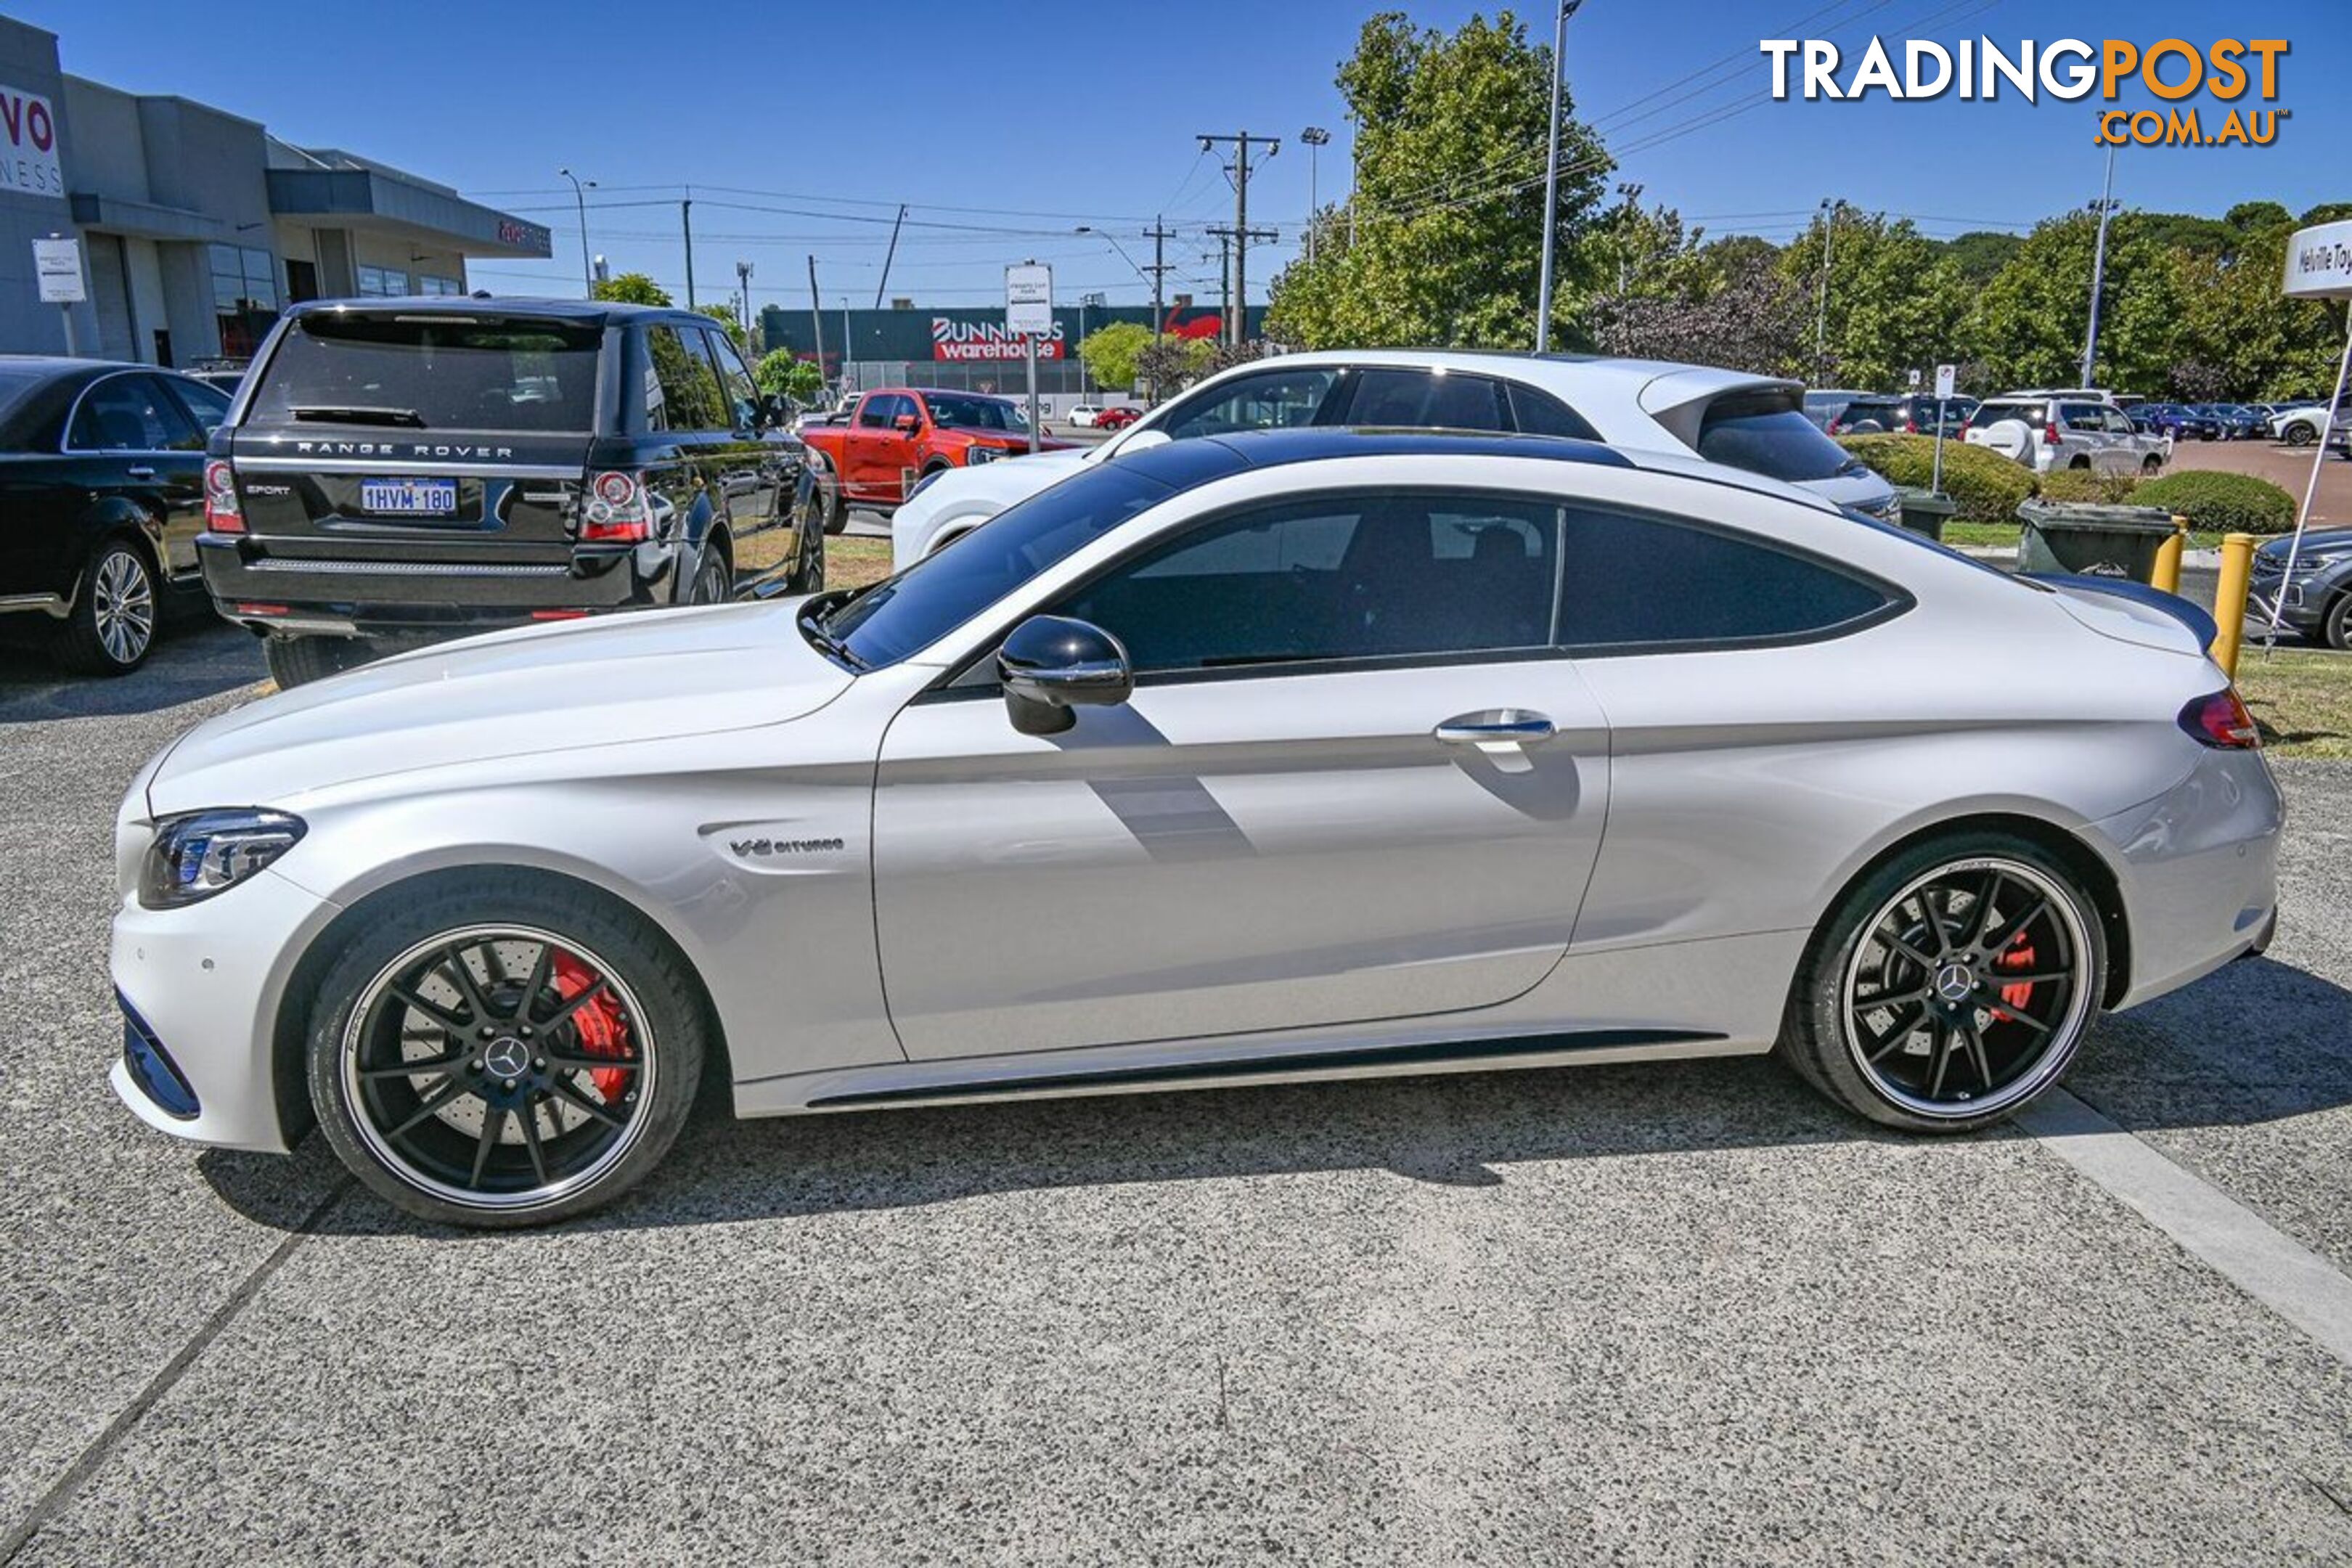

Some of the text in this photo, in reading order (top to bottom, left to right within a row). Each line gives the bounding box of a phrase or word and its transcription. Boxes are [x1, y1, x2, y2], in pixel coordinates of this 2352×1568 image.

[298, 442, 513, 457] RANGE ROVER
[246, 485, 290, 495] SPORT
[729, 838, 844, 857] V8 BITURBO
